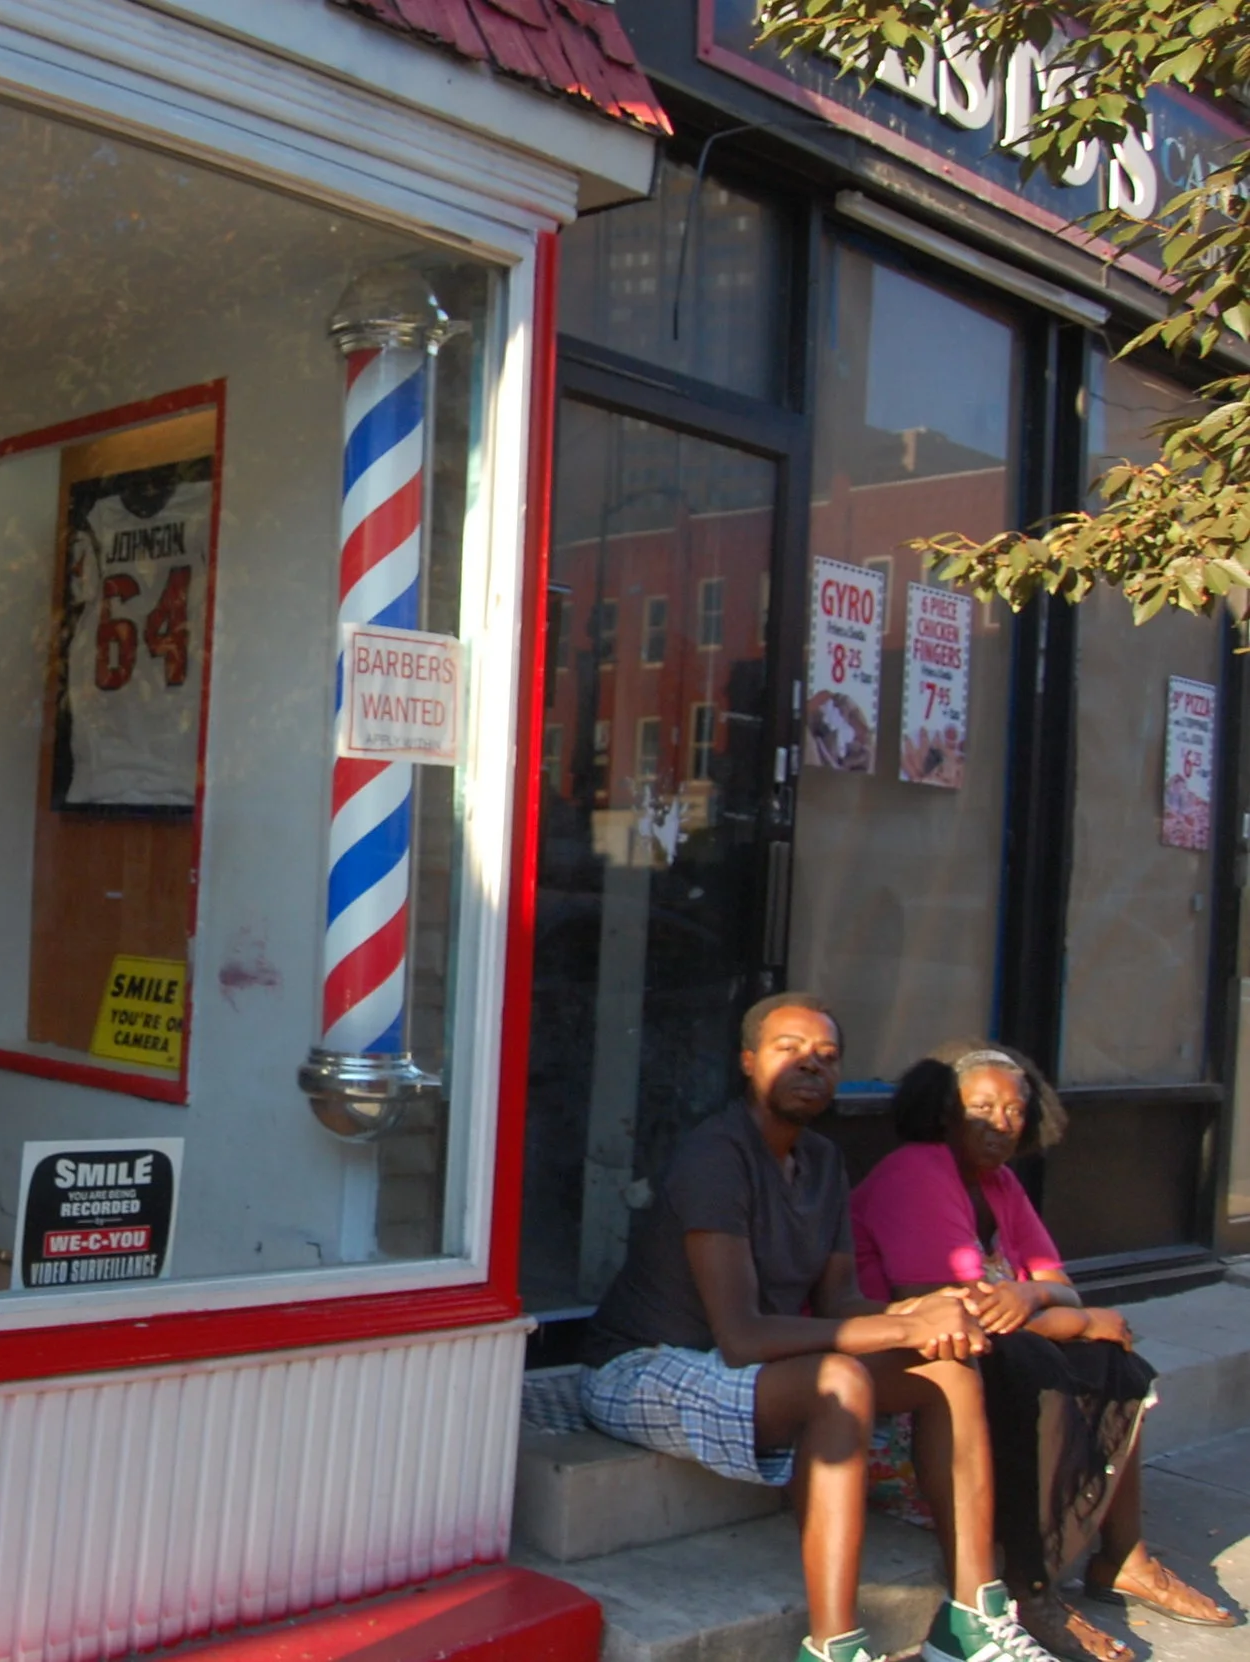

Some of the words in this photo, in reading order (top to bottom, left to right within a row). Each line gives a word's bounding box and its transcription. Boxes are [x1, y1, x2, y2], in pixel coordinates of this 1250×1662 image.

[106, 522, 186, 564] JOHNSON
[821, 578, 874, 625] GYRO
[930, 597, 958, 621] PIECE
[95, 565, 192, 691] 64
[356, 647, 455, 684] BARBERS
[913, 638, 962, 670] FINGERS
[361, 692, 446, 727] WANTED
[111, 974, 178, 1004] SMILE
[111, 1009, 162, 1030] YOU'RE
[114, 1030, 169, 1052] CAMERA
[54, 1154, 154, 1189] SMILE
[60, 1200, 141, 1217] RECORDED
[68, 1191, 88, 1201] YOU
[89, 1190, 107, 1200] ARE
[108, 1189, 137, 1199] BEING
[50, 1230, 147, 1252] WE-C-YOU
[30, 1260, 69, 1285] VIDEO
[70, 1254, 158, 1282] SURVEILLANCE
